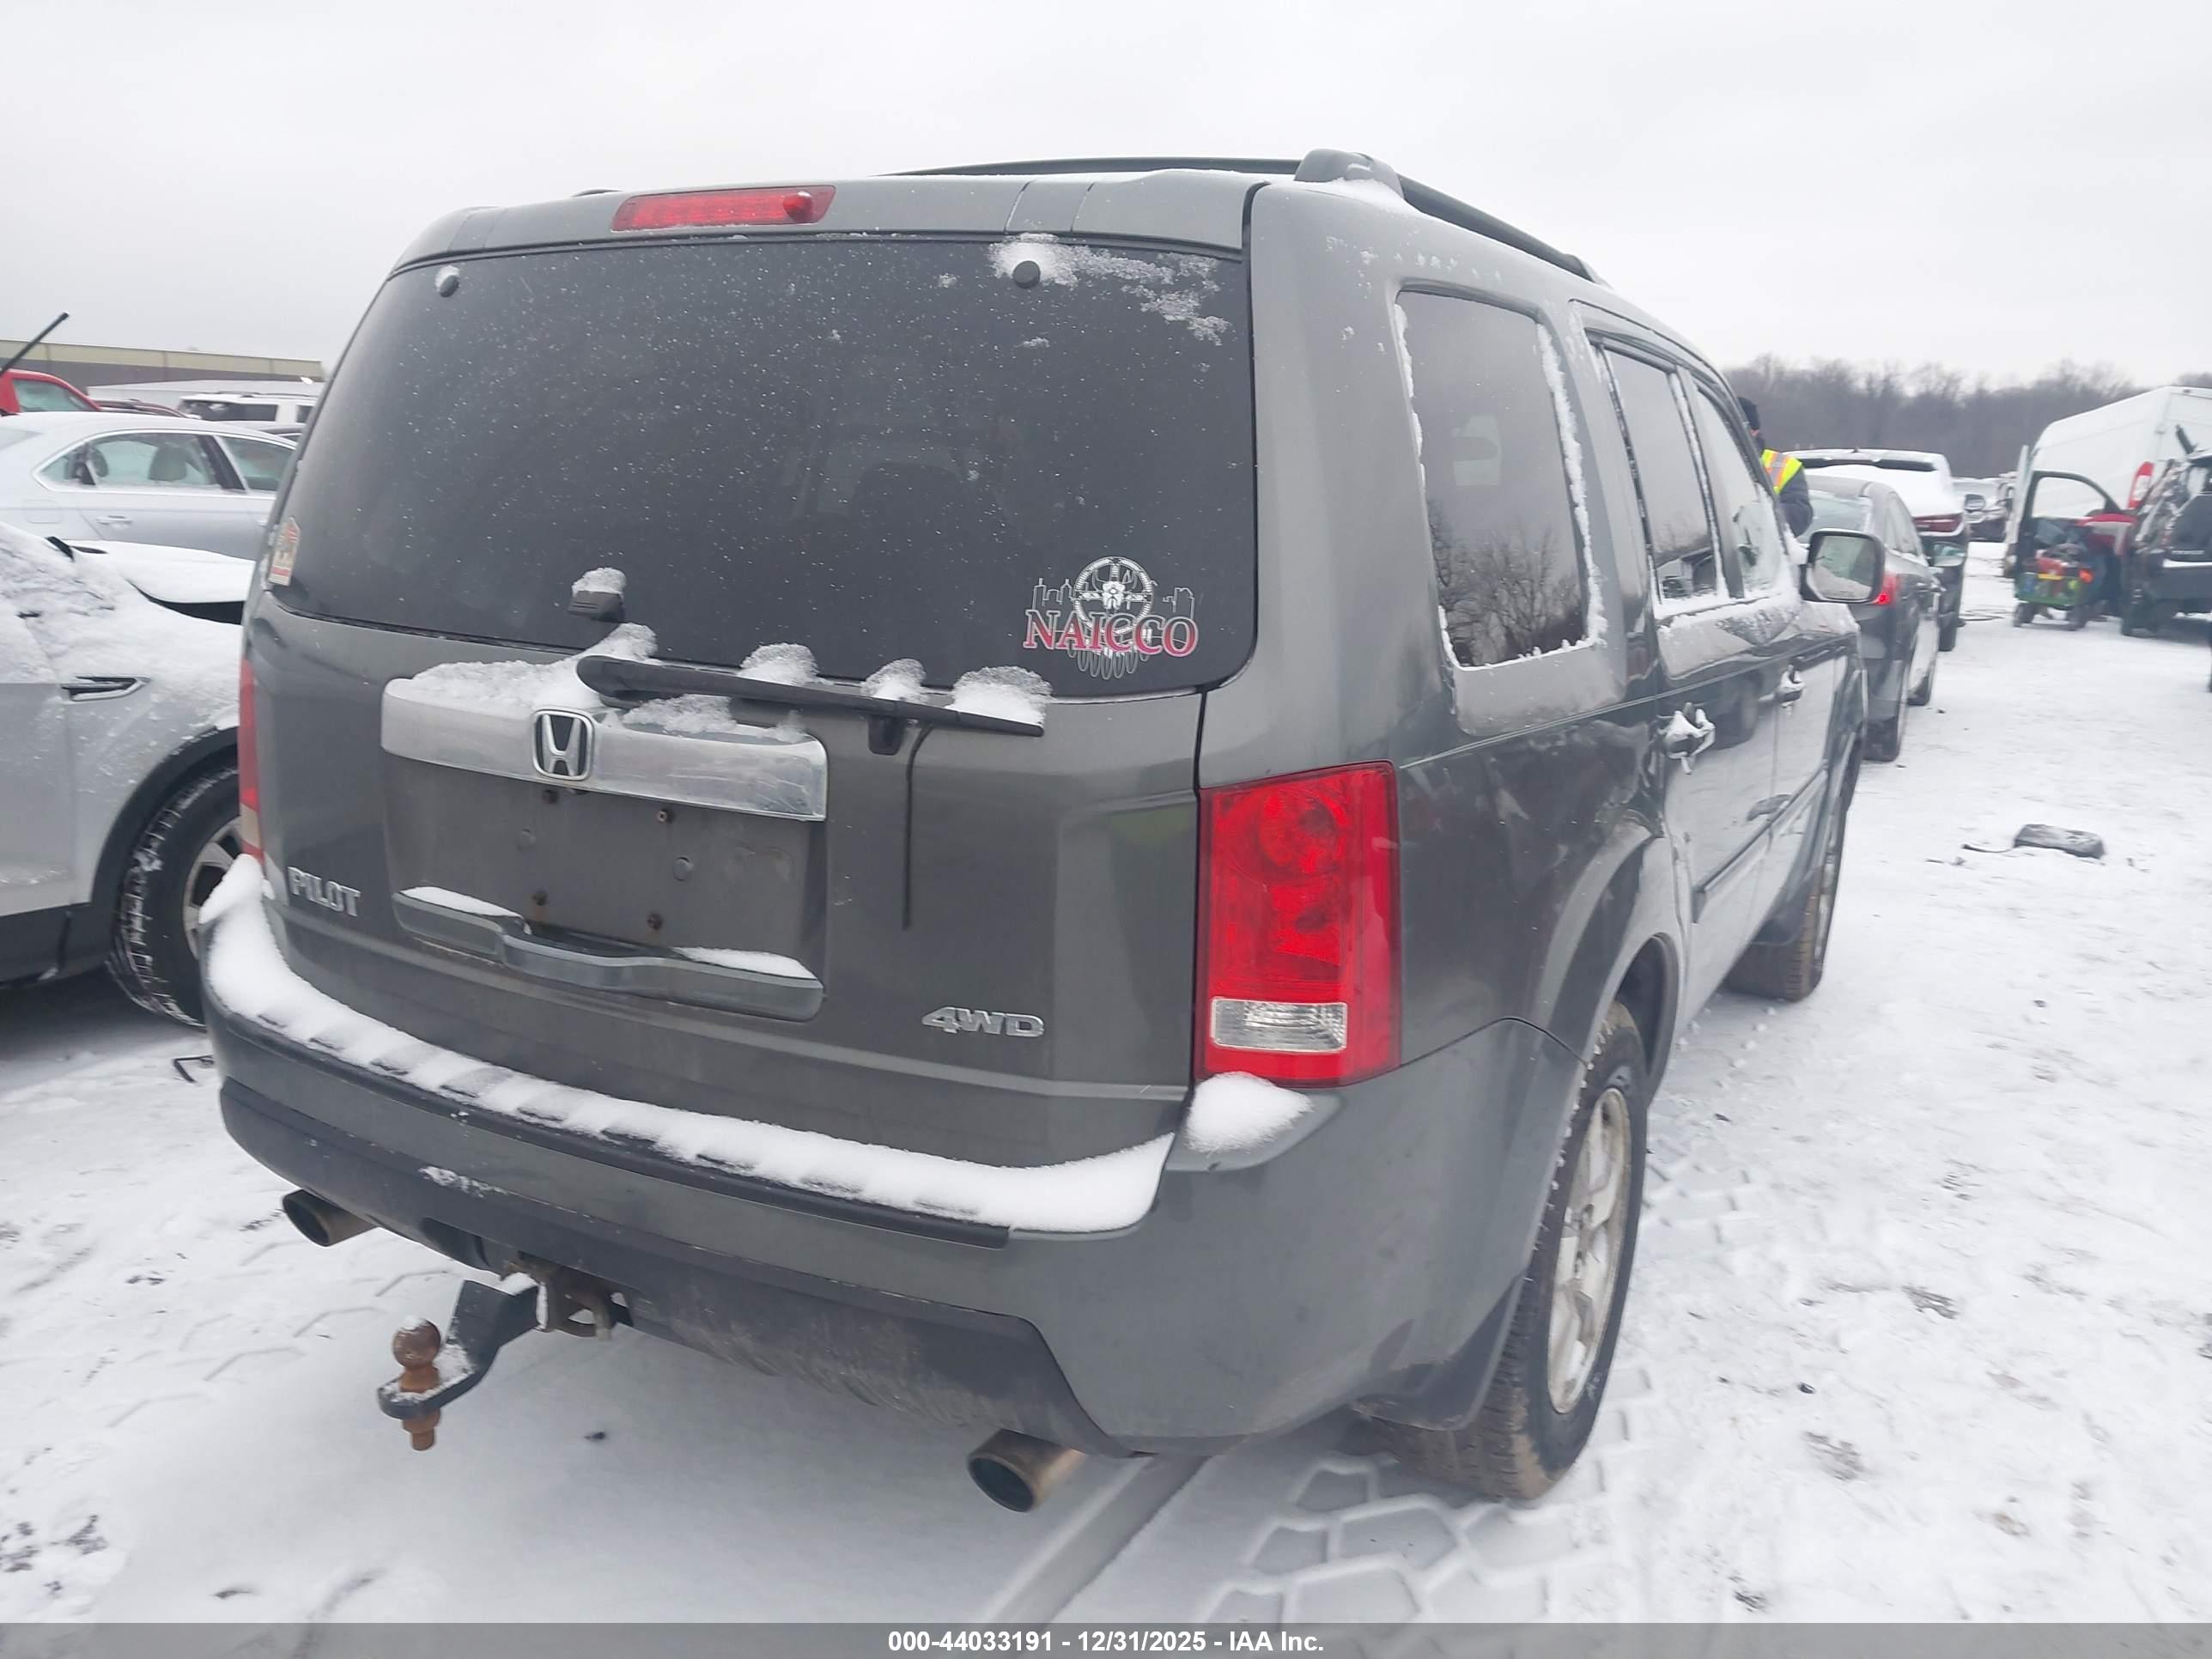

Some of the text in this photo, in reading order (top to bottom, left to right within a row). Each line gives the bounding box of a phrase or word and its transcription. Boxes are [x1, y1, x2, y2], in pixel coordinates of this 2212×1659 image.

[1023, 609, 1199, 658] NAICCO
[287, 866, 362, 917] PILOT
[921, 1006, 1045, 1038] 4WD
